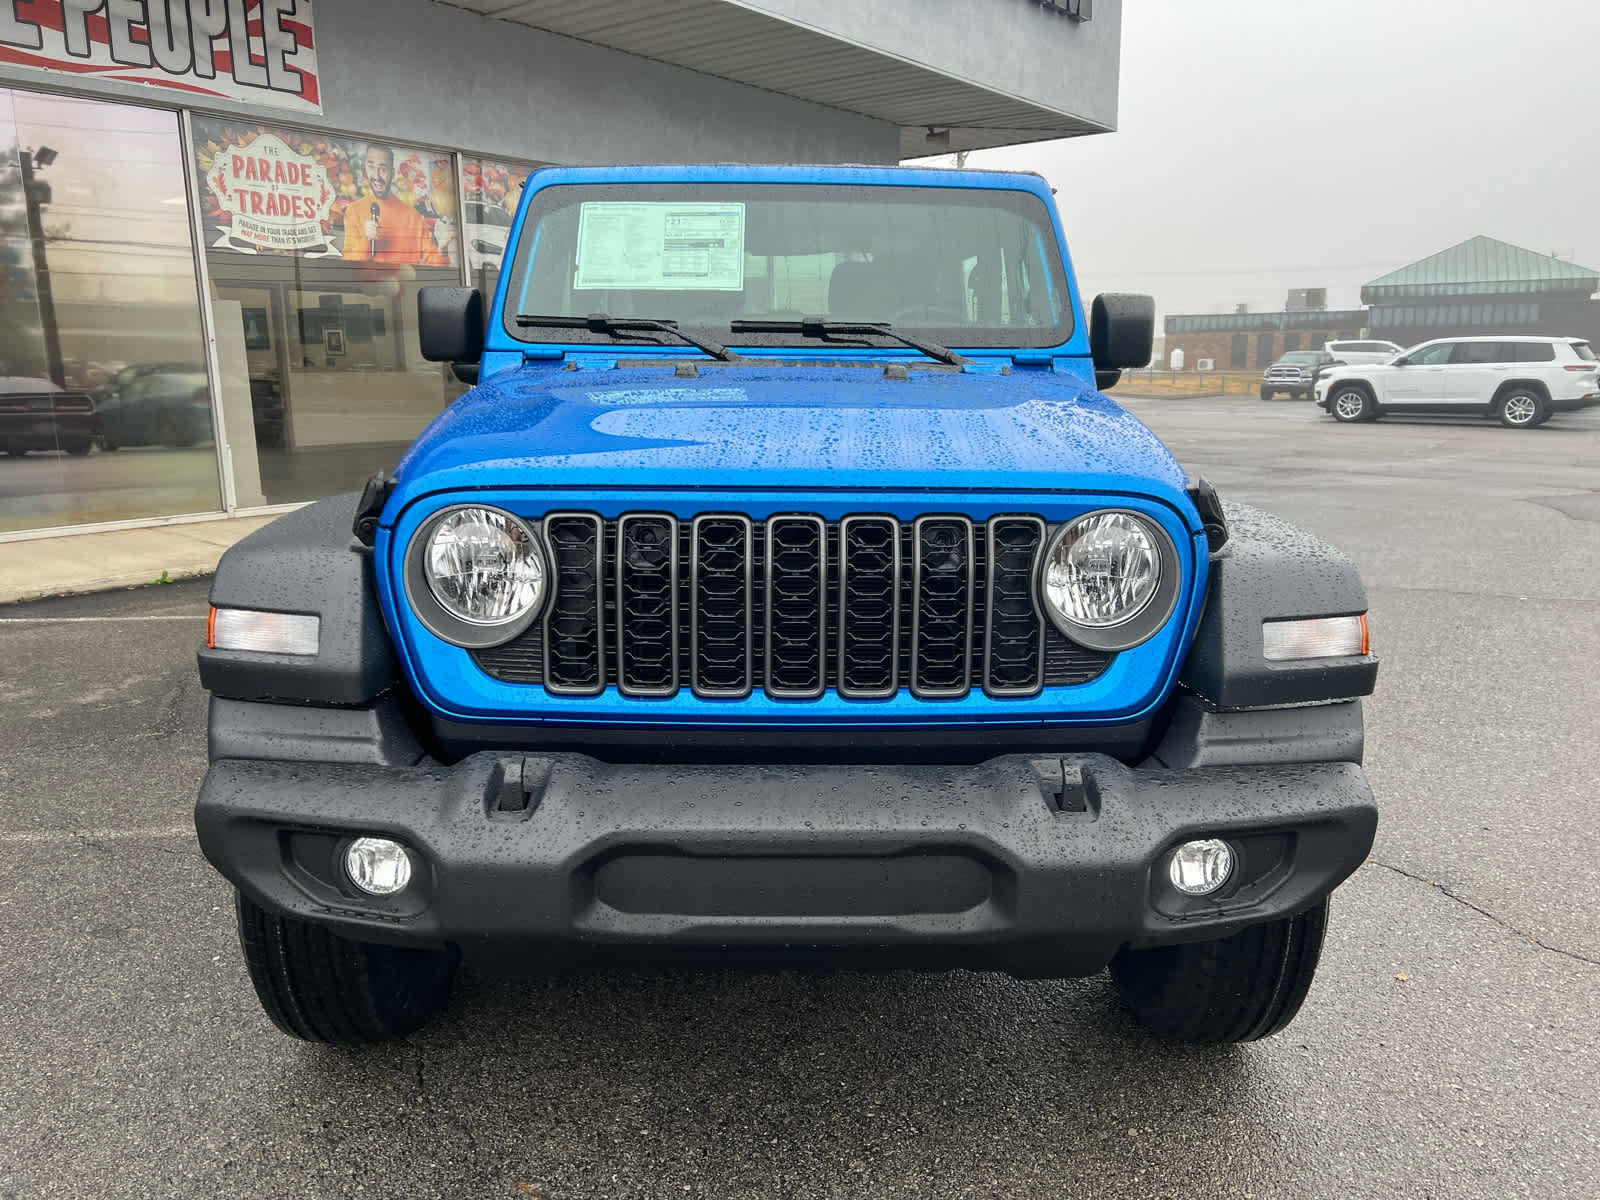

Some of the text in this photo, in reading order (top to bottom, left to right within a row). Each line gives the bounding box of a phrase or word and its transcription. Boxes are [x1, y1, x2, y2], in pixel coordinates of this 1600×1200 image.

[62, 0, 304, 94] PEOPLE
[264, 145, 279, 157] THE
[231, 154, 313, 187] PARADE
[233, 188, 317, 219] TRADES
